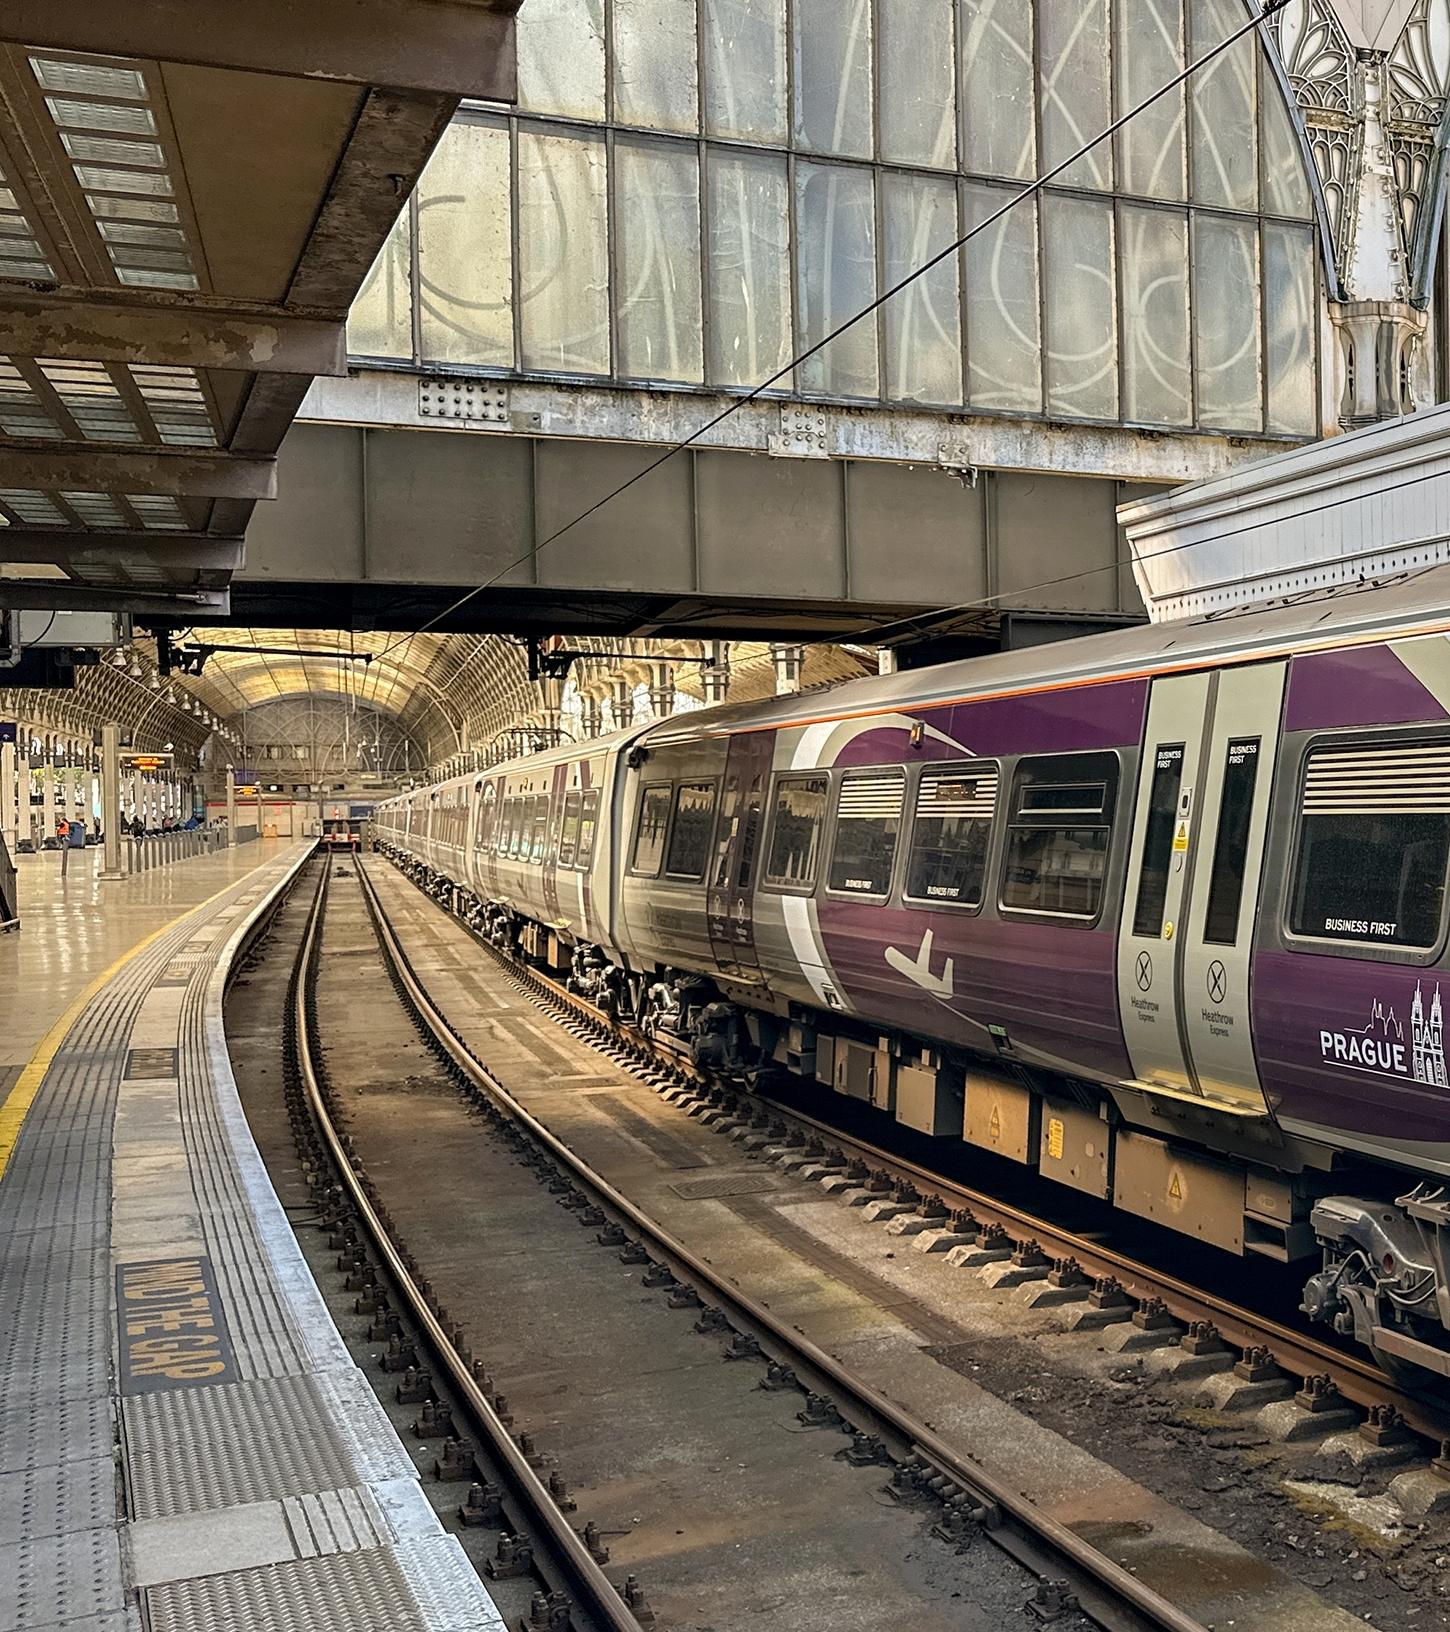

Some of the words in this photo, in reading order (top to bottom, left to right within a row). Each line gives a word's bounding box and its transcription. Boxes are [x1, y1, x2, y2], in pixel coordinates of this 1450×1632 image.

[1158, 751, 1182, 760] BUSINESS
[1230, 745, 1257, 755] BUSINESS
[1157, 760, 1171, 769] FIRST
[1228, 755, 1245, 764] FIRST
[1325, 918, 1369, 934] BUSINESS
[1369, 923, 1397, 936] FIRST
[1131, 996, 1159, 1012] Heathrow
[1138, 1011, 1155, 1023] Express
[1201, 1008, 1234, 1026] Heathrow
[1210, 1024, 1230, 1037] Express
[1320, 1030, 1408, 1072] PRAGUE
[123, 1260, 206, 1299] MIND
[125, 1296, 214, 1336] THE
[129, 1334, 225, 1379] GAP
